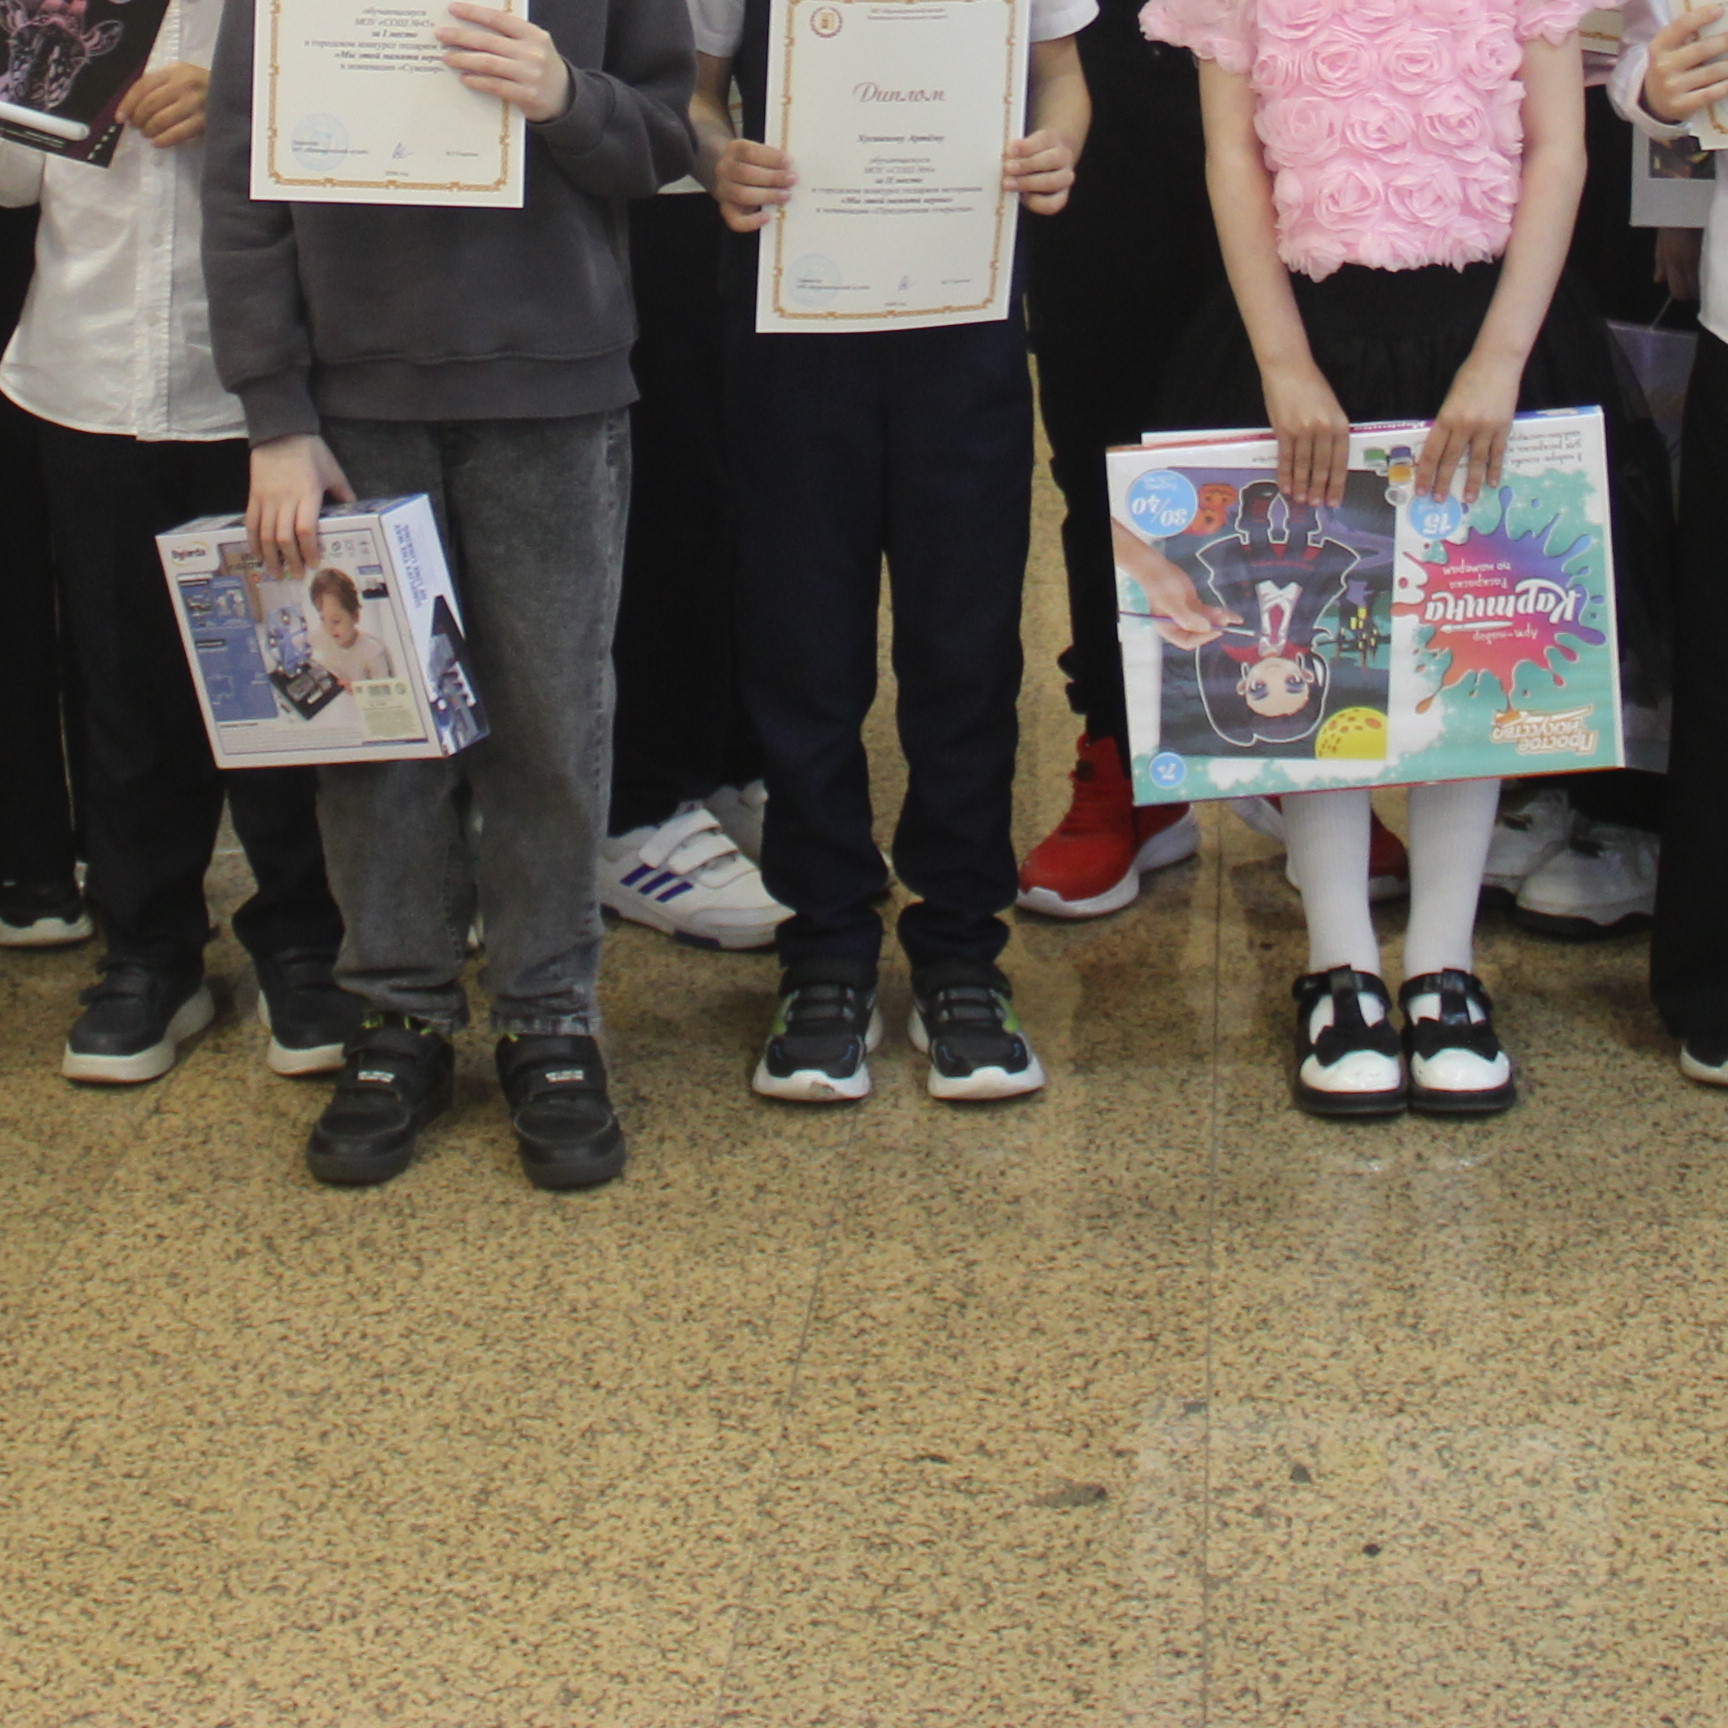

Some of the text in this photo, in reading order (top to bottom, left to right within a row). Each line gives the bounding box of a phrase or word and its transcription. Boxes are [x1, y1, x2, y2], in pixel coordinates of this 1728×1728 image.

[852, 81, 946, 103] Диплом
[1423, 512, 1453, 535] 15
[1442, 559, 1512, 575] по номерам
[1424, 578, 1581, 624] Картина
[1473, 623, 1538, 644] Арт-набор
